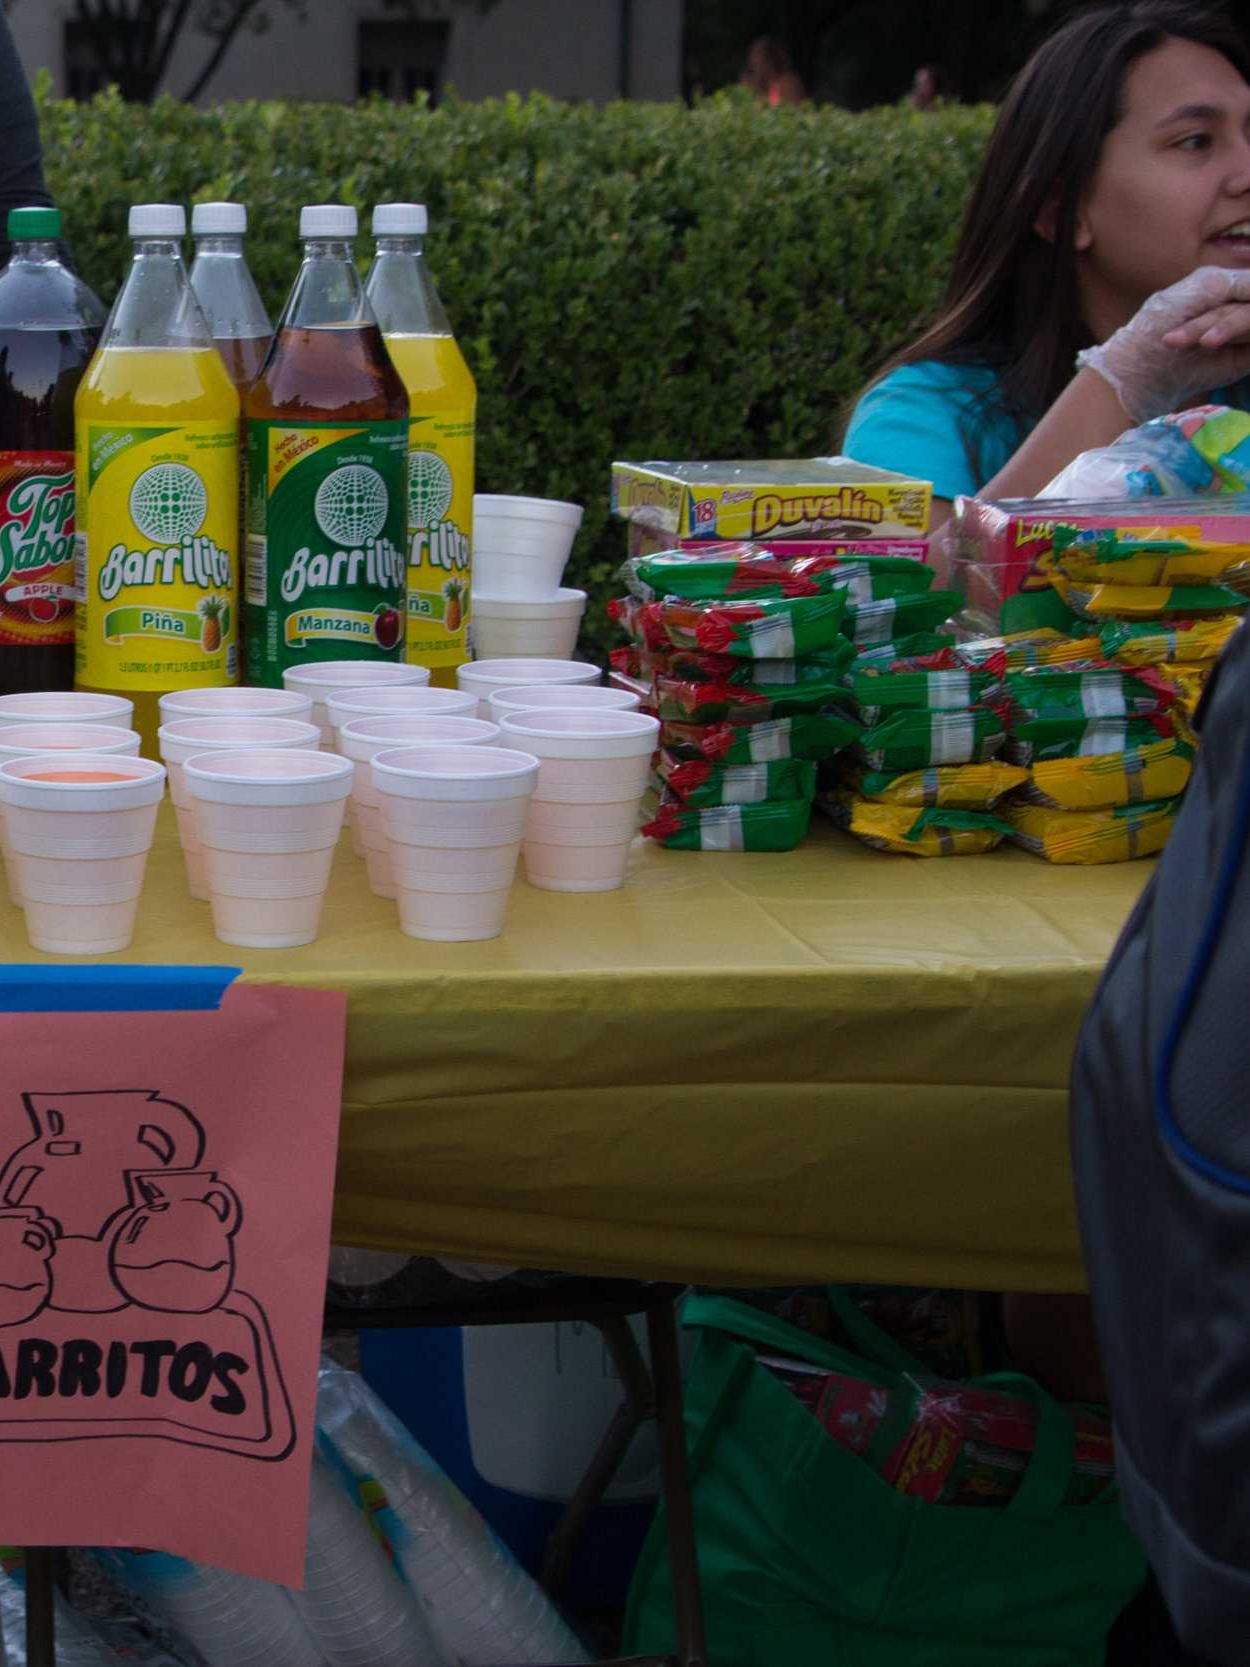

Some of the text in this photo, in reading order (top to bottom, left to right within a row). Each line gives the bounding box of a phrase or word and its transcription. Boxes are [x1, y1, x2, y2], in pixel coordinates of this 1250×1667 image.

[7, 471, 75, 541] Top
[24, 585, 63, 596] APPLE
[408, 594, 430, 611] ña
[142, 612, 184, 633] Piña
[298, 615, 370, 635] Manzana
